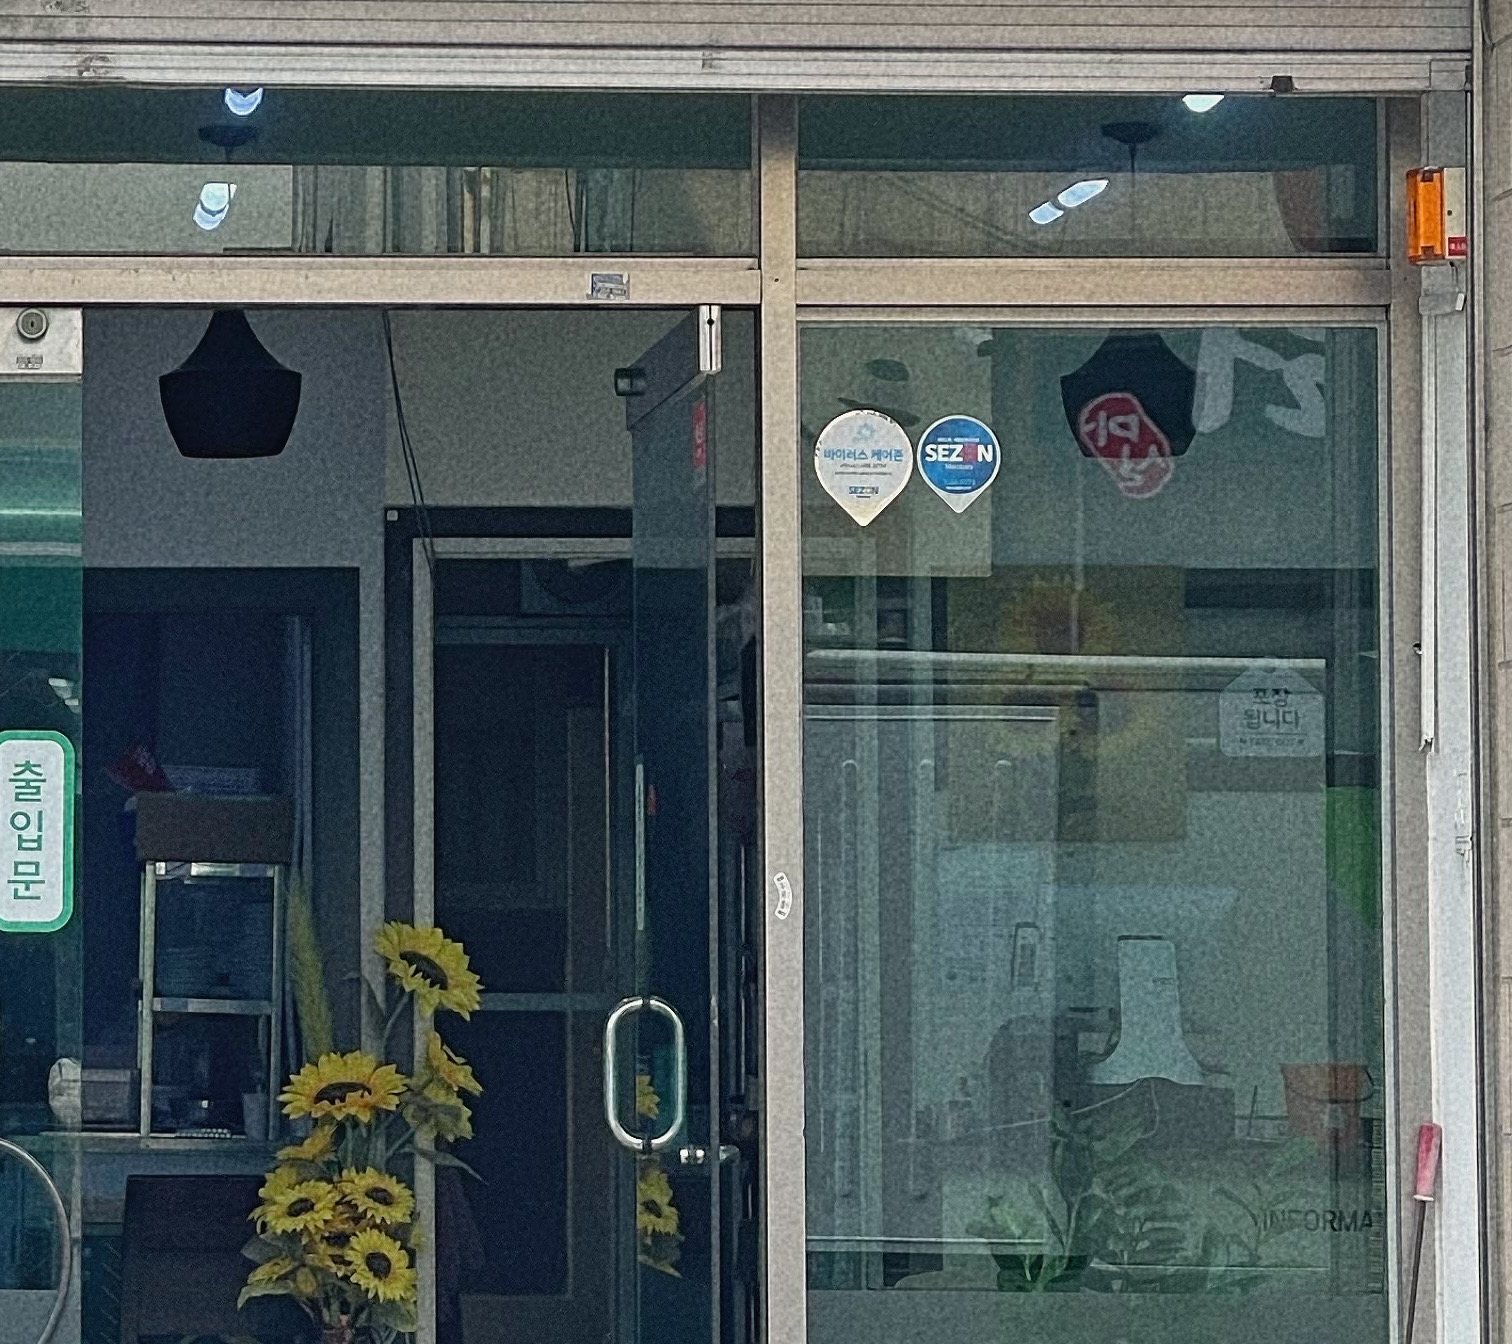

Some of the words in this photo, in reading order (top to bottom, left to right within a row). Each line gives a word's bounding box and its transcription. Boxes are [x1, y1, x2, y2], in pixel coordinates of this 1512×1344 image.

[823, 448, 869, 461] 바이러스
[1243, 707, 1302, 731] 됩니다
[7, 759, 47, 901] 출입문
